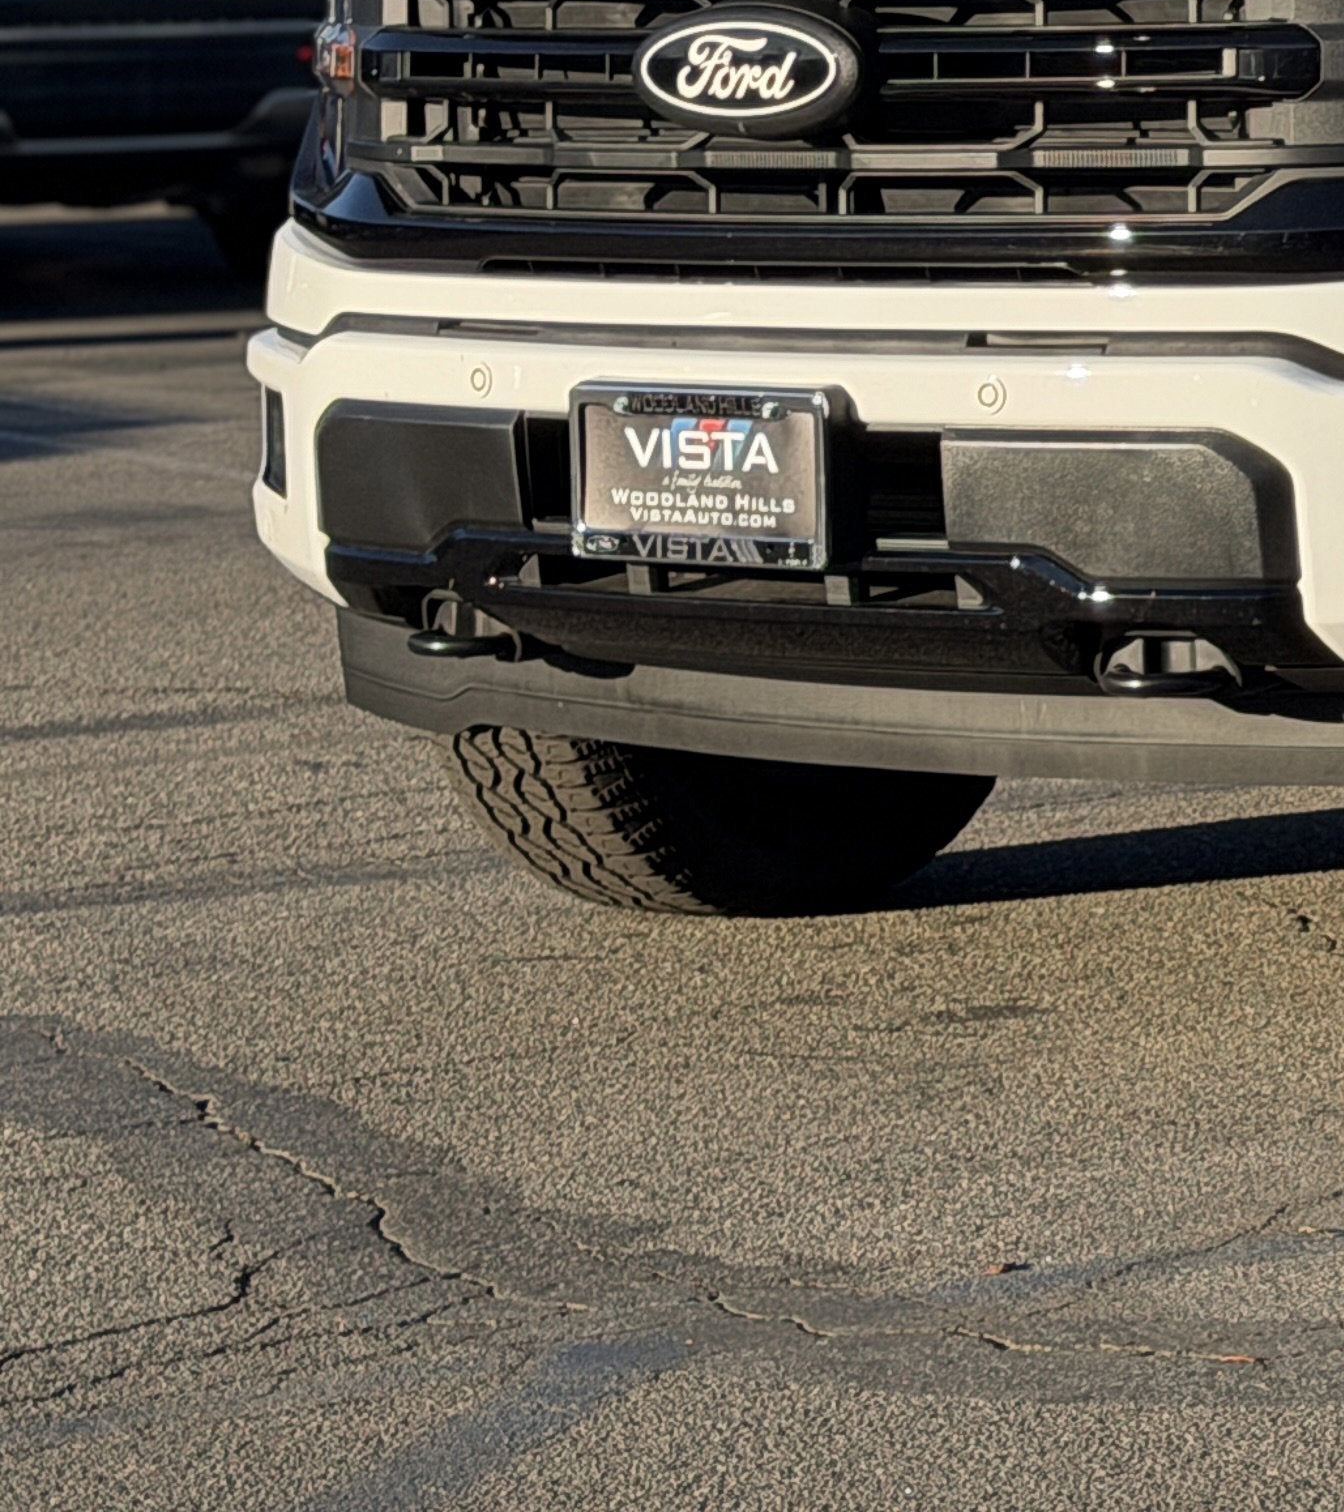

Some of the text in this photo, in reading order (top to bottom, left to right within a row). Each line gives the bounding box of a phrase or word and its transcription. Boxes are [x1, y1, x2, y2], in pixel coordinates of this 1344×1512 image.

[677, 35, 797, 99] Ford
[624, 427, 779, 473] VISTA
[611, 488, 795, 514] WOODLAND HILLS
[632, 534, 734, 562] VISTA
